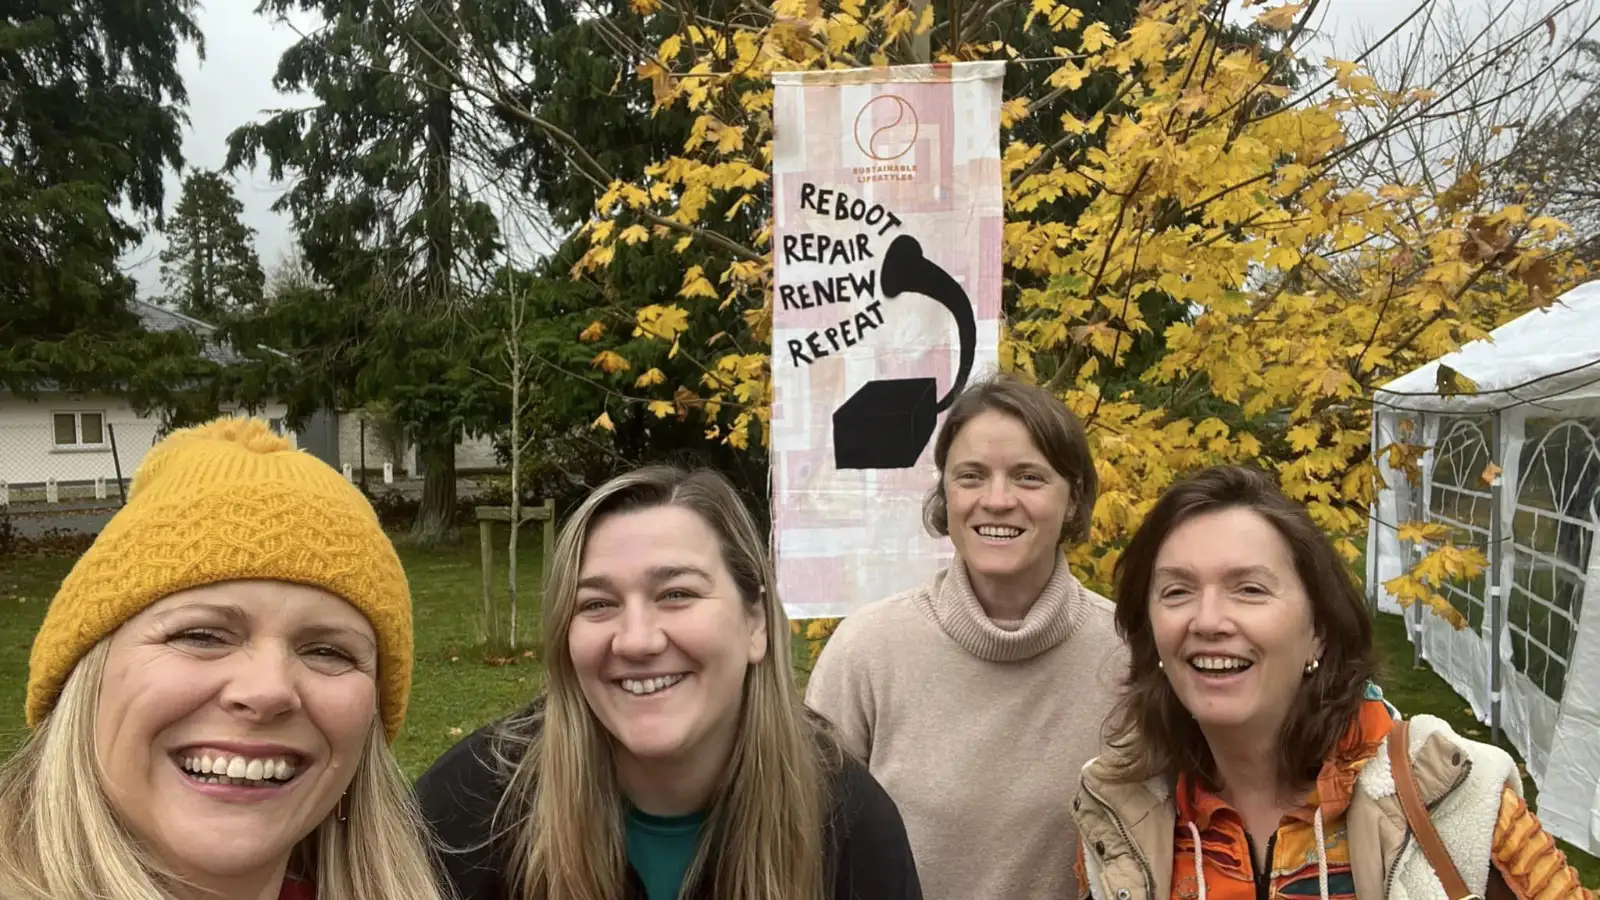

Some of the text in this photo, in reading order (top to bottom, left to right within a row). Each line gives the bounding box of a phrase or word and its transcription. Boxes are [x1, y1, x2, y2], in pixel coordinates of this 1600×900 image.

[852, 165, 918, 175] SUSTAINABLE
[800, 182, 902, 236] REBOOT
[783, 233, 874, 265] REPAIR
[779, 269, 876, 311] RENEW
[787, 299, 885, 368] REPEAT
